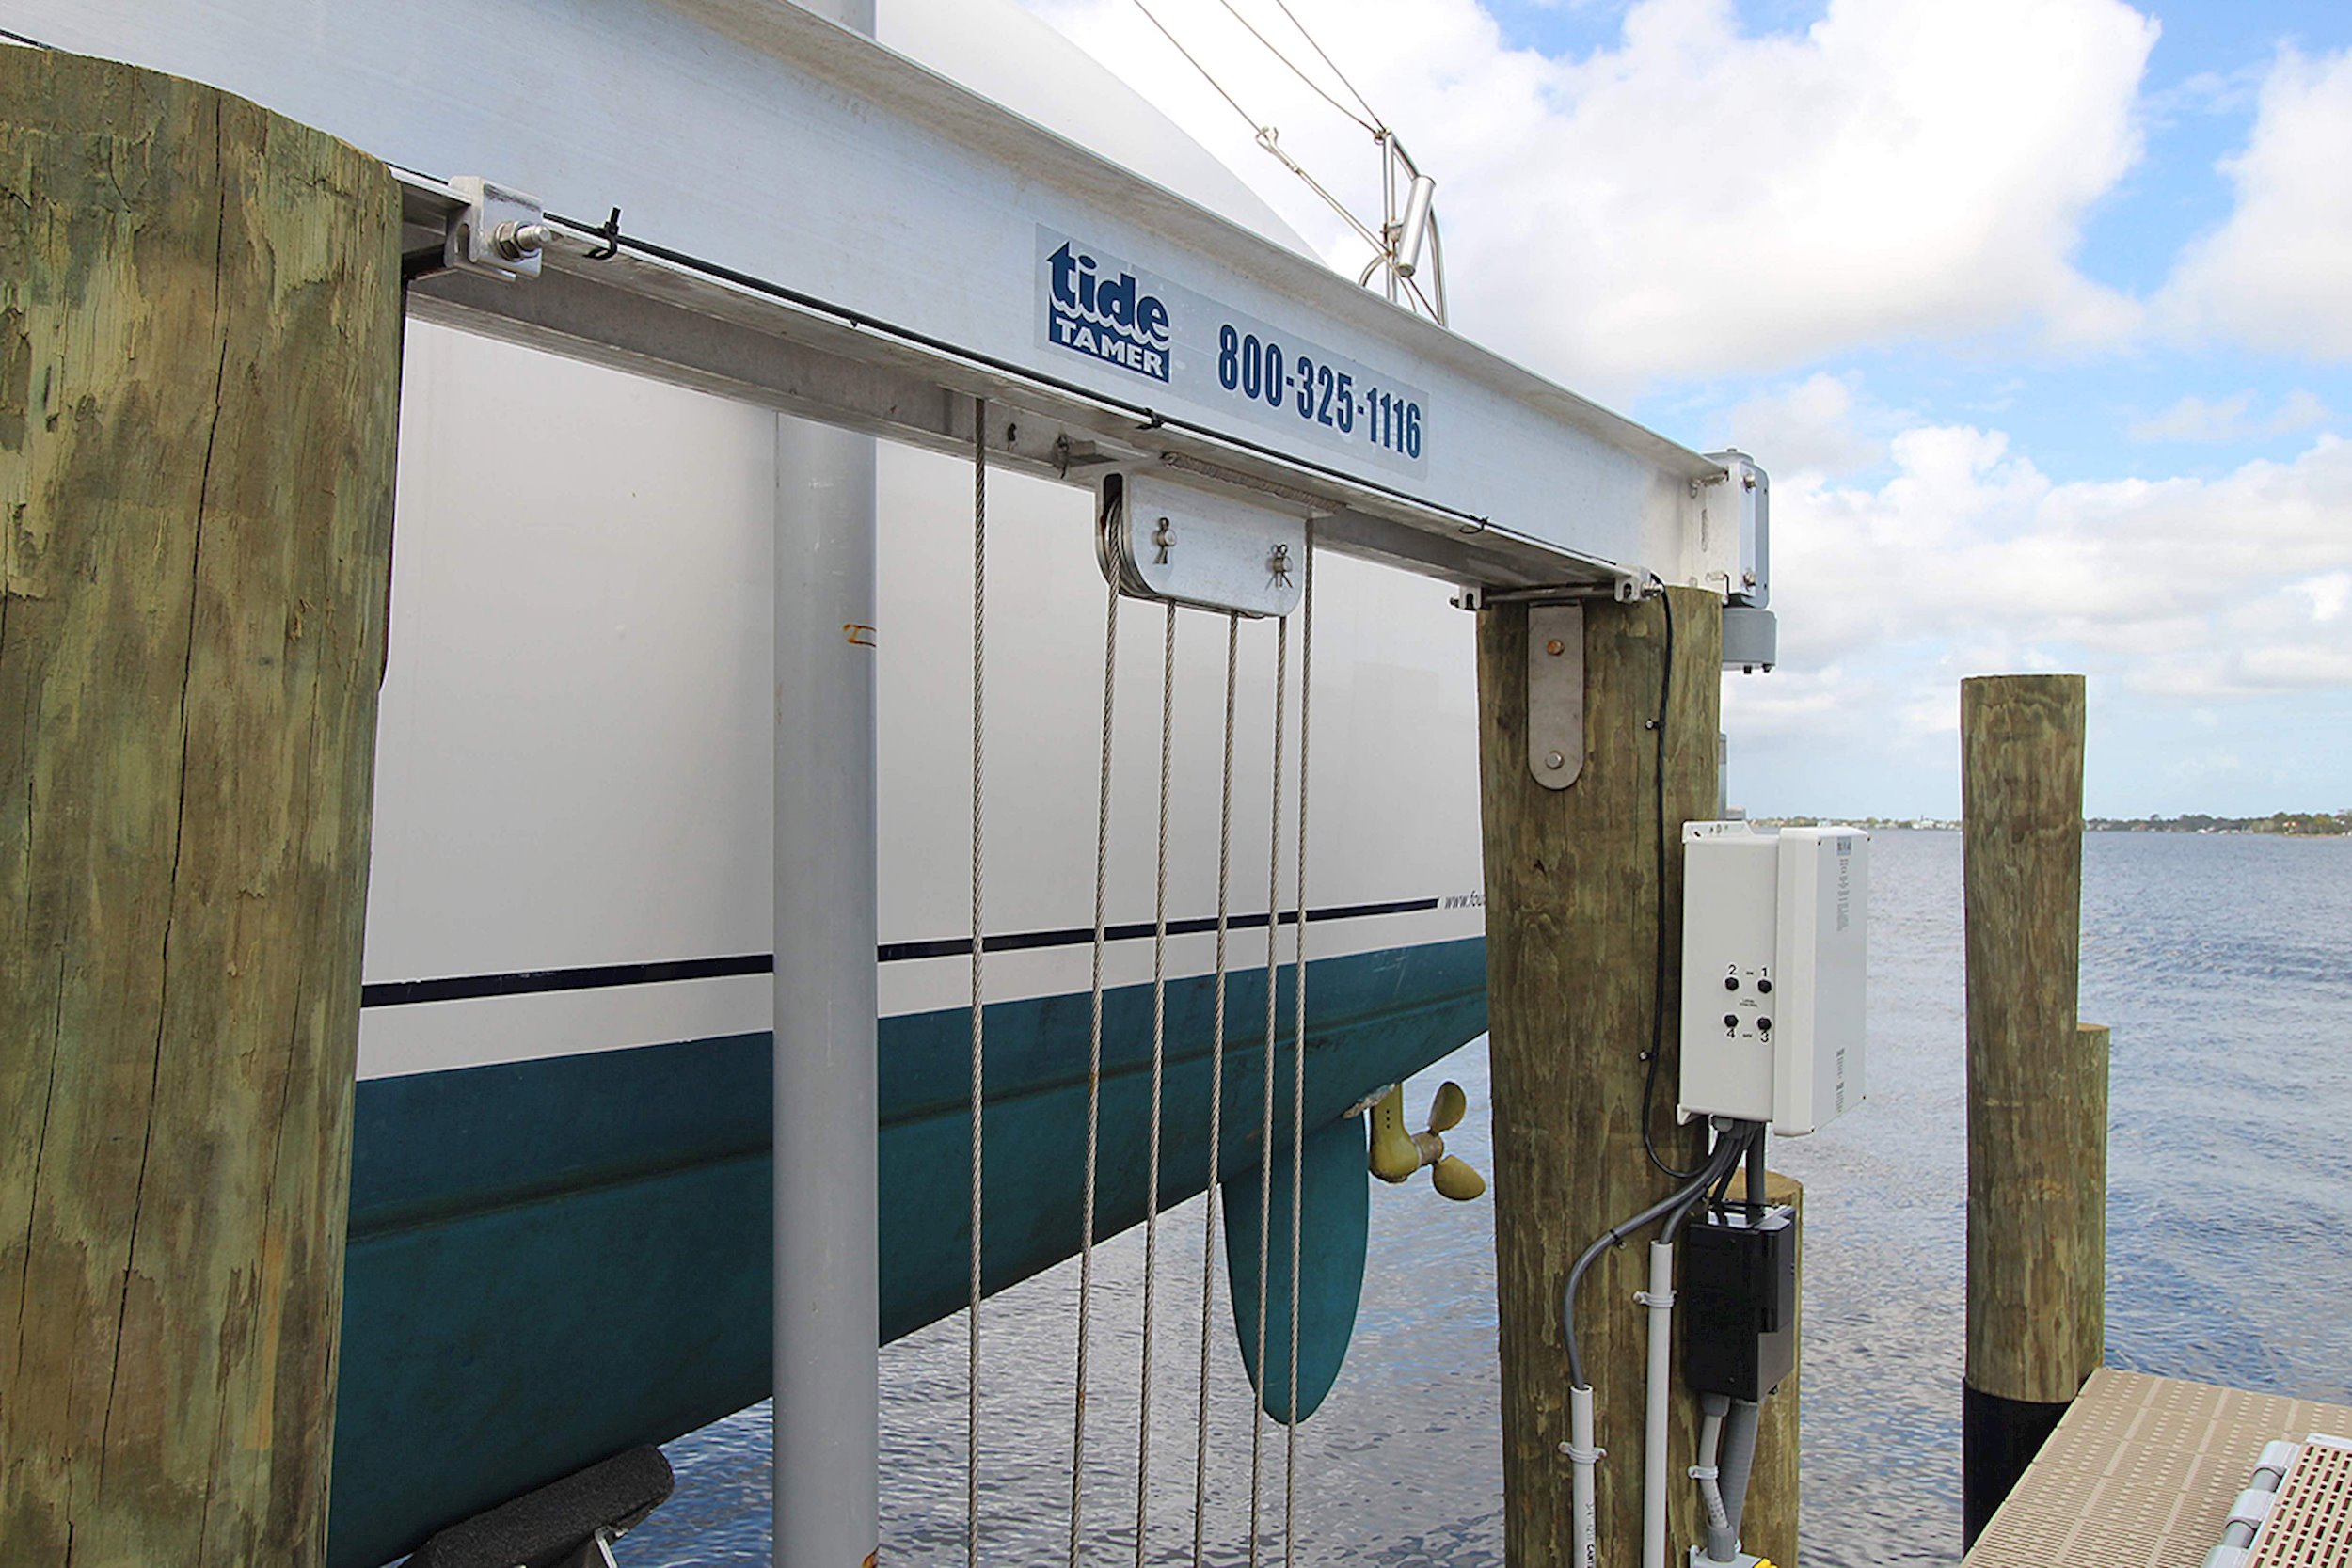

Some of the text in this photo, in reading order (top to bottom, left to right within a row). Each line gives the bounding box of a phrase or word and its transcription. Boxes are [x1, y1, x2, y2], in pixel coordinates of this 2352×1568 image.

[1047, 242, 1168, 341] tide
[1056, 316, 1164, 377] TAMER
[1219, 325, 1421, 459] 800-325-1116
[1728, 964, 1737, 975] 2
[1761, 967, 1768, 977] 1
[1726, 1028, 1769, 1043] 4 3
